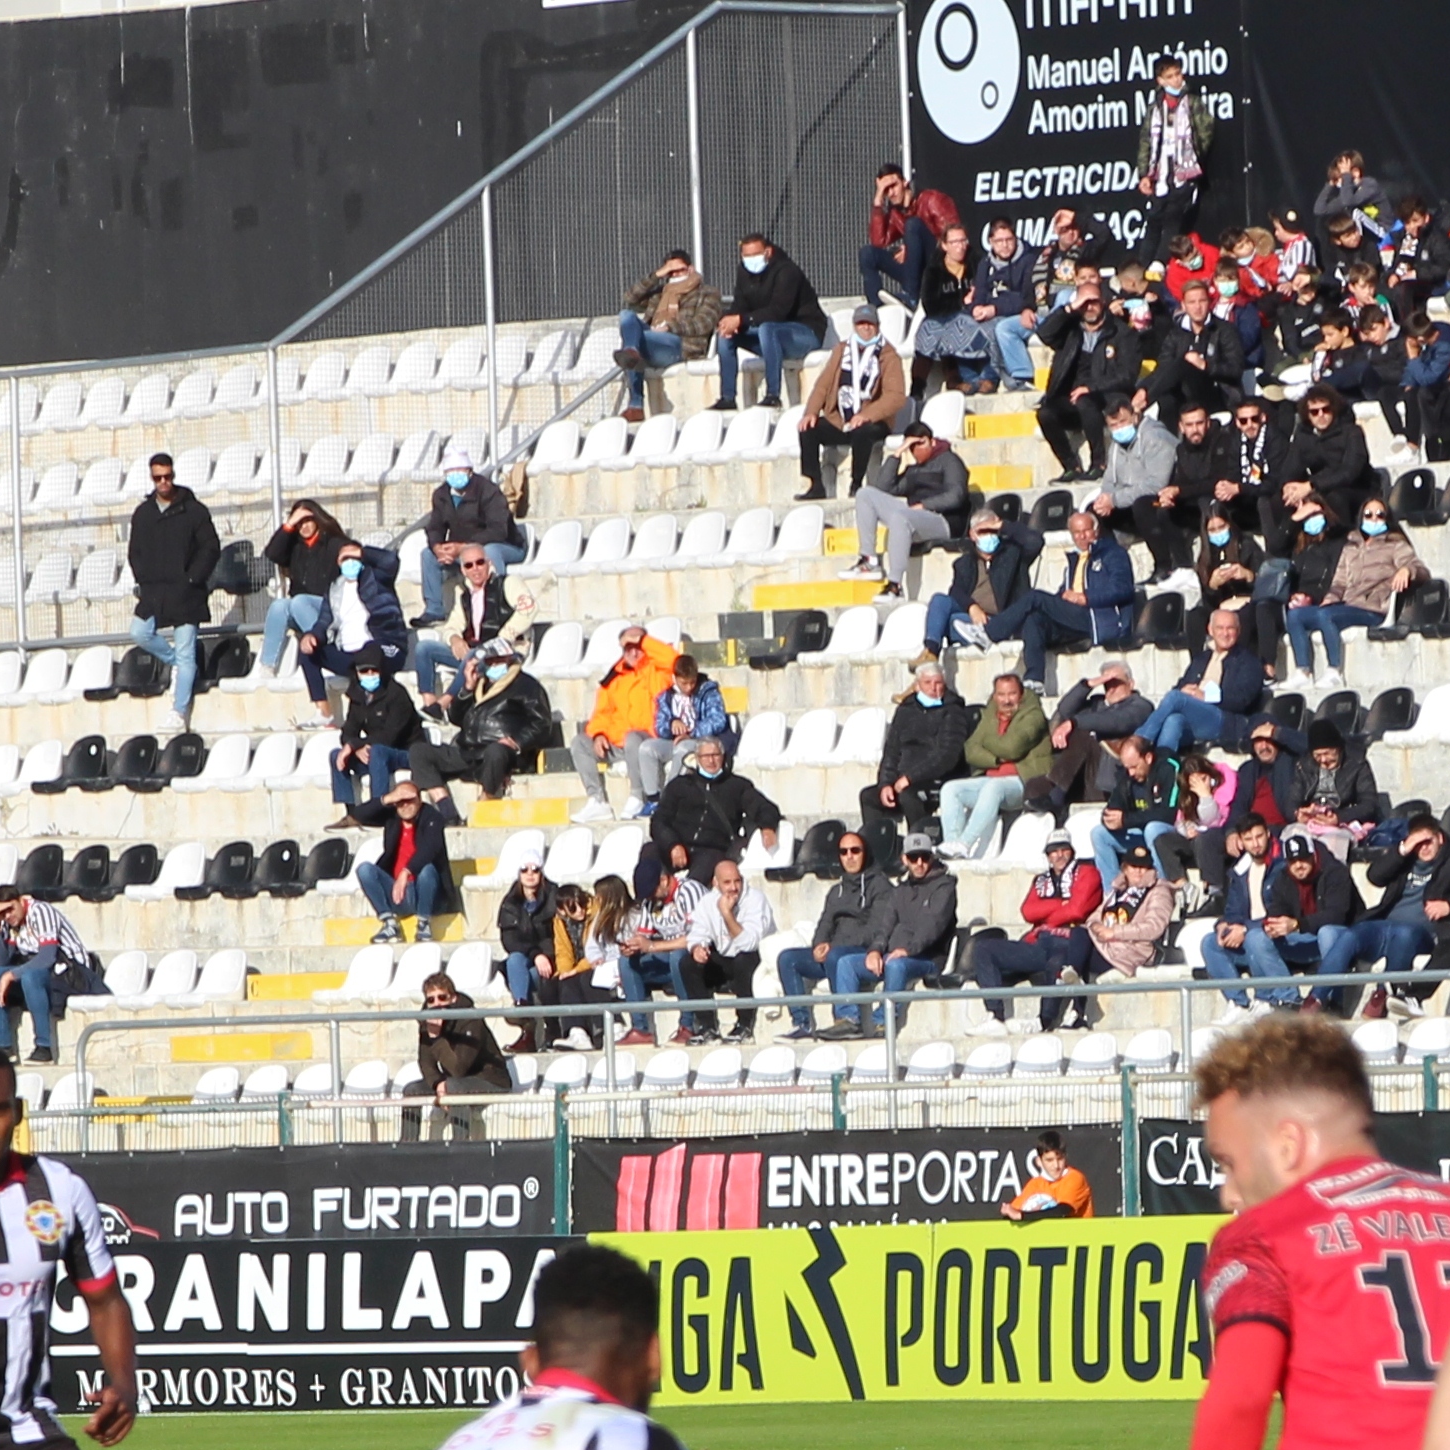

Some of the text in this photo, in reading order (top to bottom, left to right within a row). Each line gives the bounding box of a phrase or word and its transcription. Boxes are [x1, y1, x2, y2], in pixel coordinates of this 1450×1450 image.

[1027, 48, 1120, 91] Manuel
[1028, 94, 1127, 135] Amorim
[173, 1191, 289, 1238] AUTO
[76, 1366, 534, 1410] MRMORES + GRANITO
